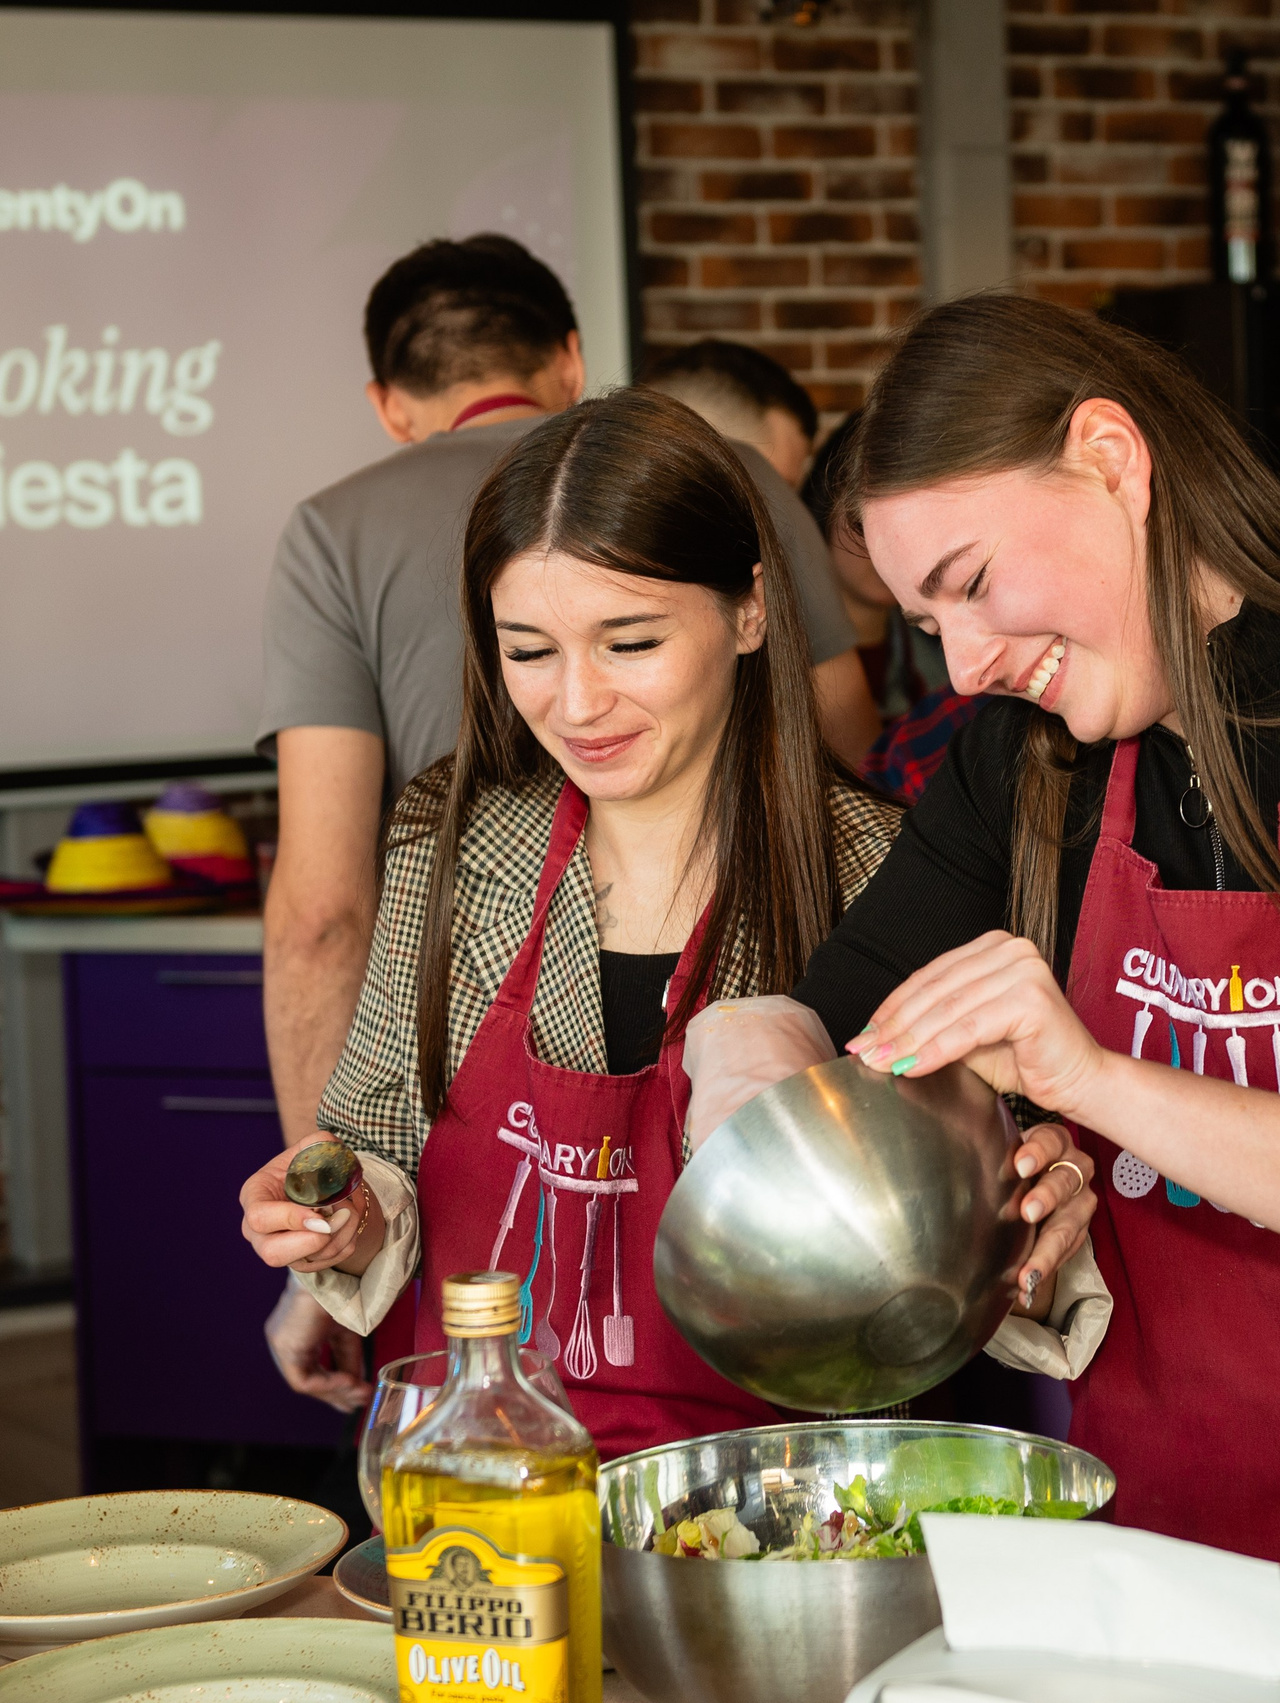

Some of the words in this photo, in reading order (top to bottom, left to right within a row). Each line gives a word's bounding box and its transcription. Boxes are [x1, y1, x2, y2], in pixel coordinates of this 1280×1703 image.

[0, 325, 221, 436] oking
[407, 1591, 522, 1614] FILIPPO
[401, 1608, 533, 1638] BERIO
[409, 1644, 481, 1684] OLIVE
[482, 1648, 526, 1692] OIL
